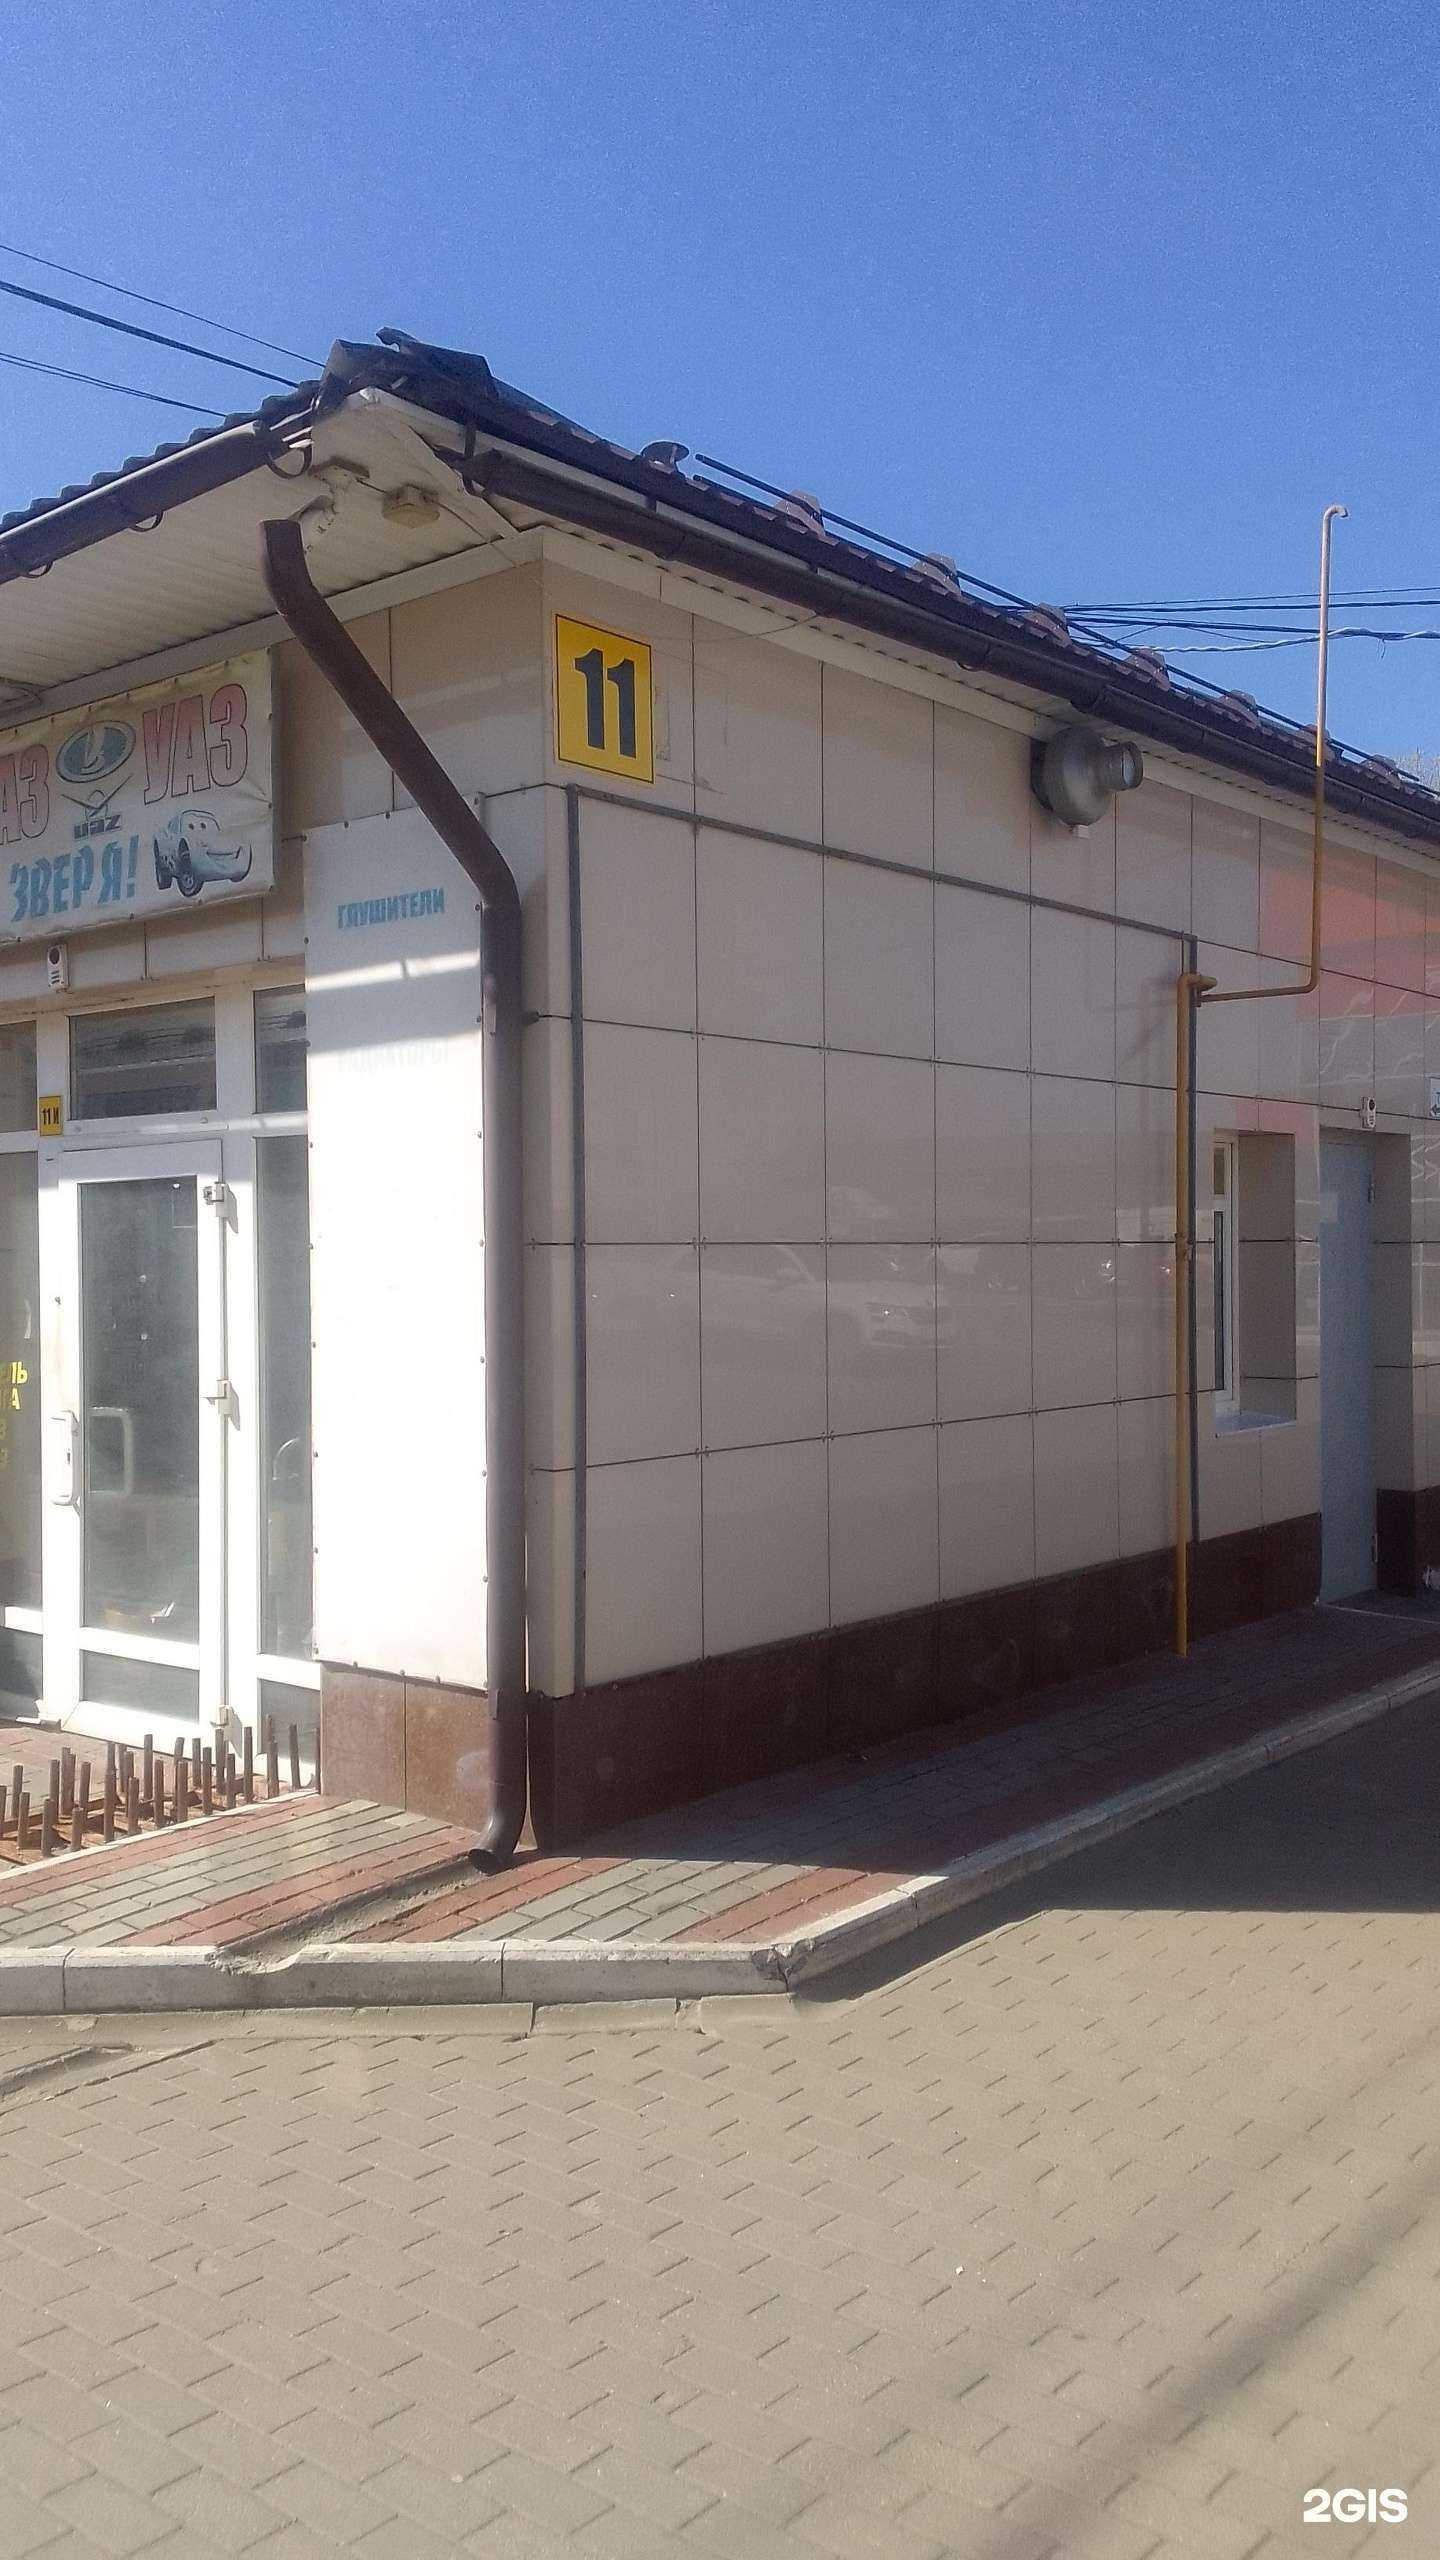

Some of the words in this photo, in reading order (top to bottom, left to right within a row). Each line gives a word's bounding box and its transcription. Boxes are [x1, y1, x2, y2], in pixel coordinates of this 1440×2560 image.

[142, 683, 248, 805] УАЗ
[574, 648, 637, 758] 11
[338, 888, 444, 929] ГЛУШИТЕЛИ
